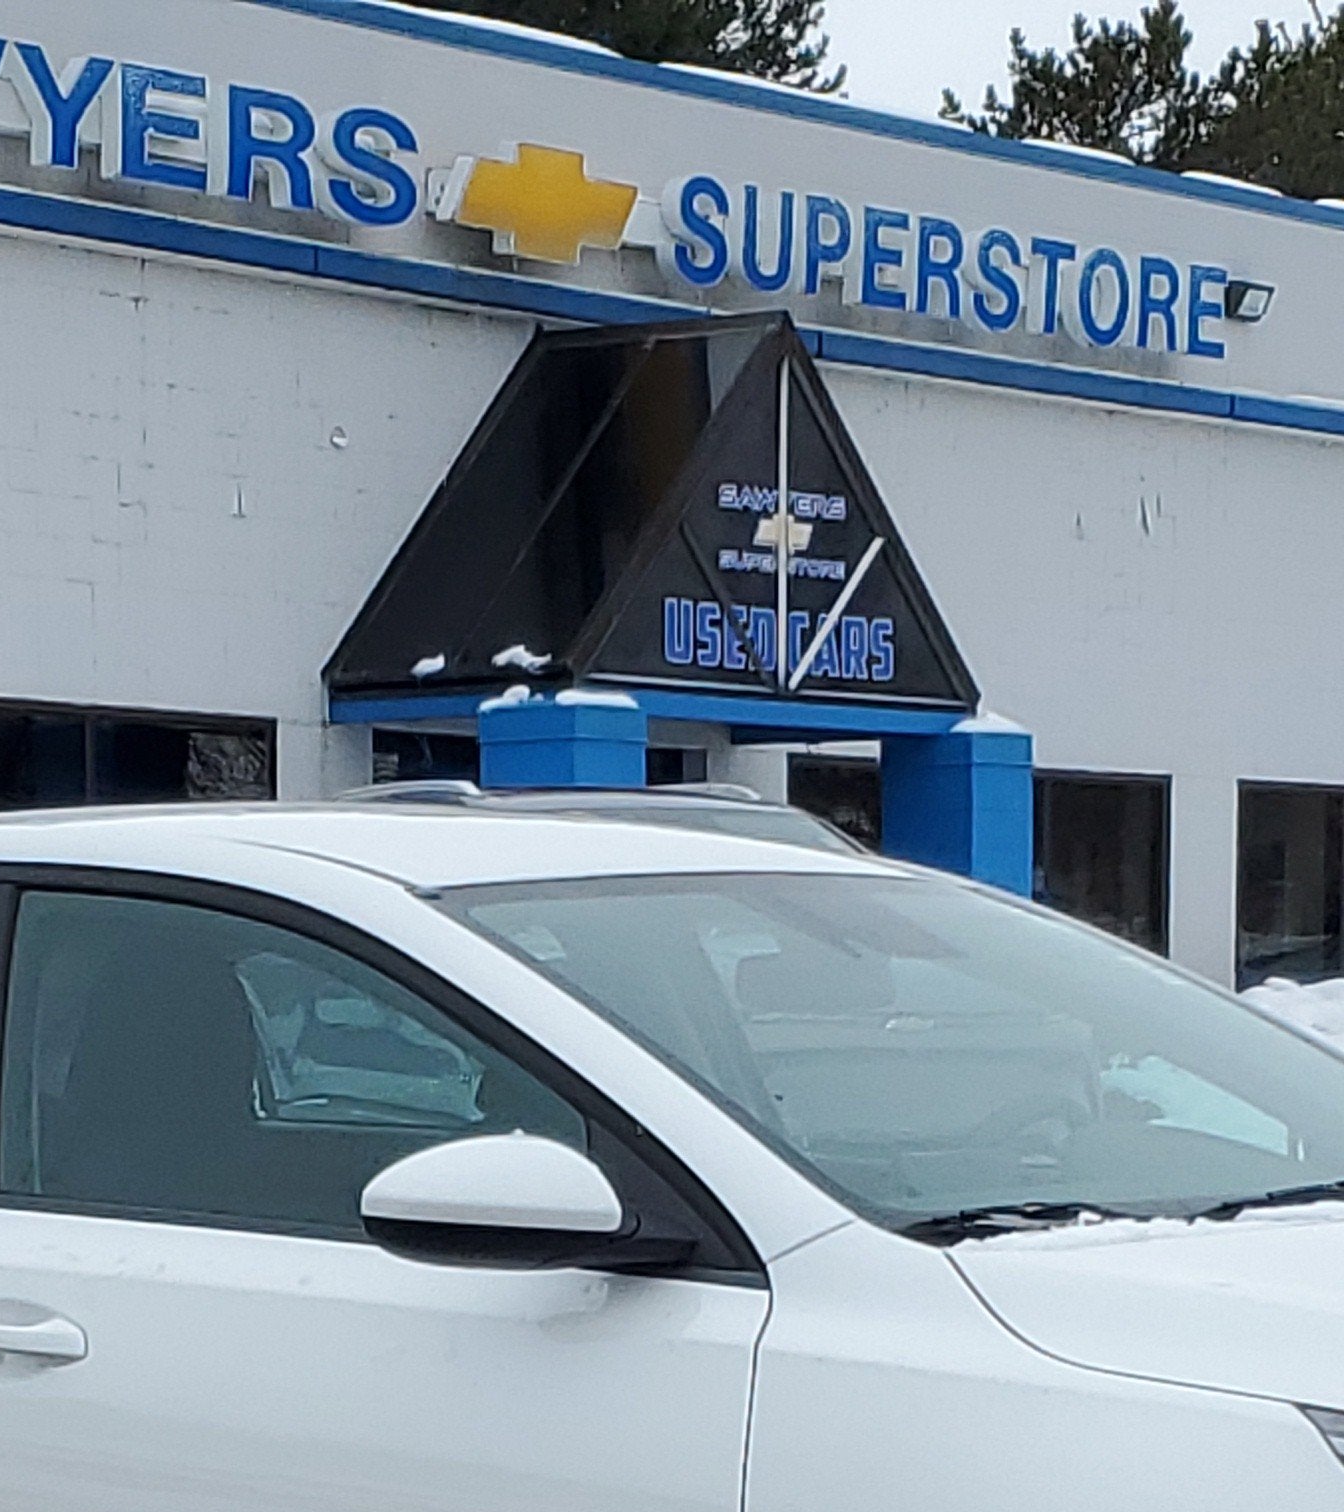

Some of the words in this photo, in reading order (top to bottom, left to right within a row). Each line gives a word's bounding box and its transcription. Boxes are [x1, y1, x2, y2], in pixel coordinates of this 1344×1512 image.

[676, 176, 1228, 358] SUPERSTORE
[664, 597, 777, 672] USED
[788, 611, 895, 682] CARS
